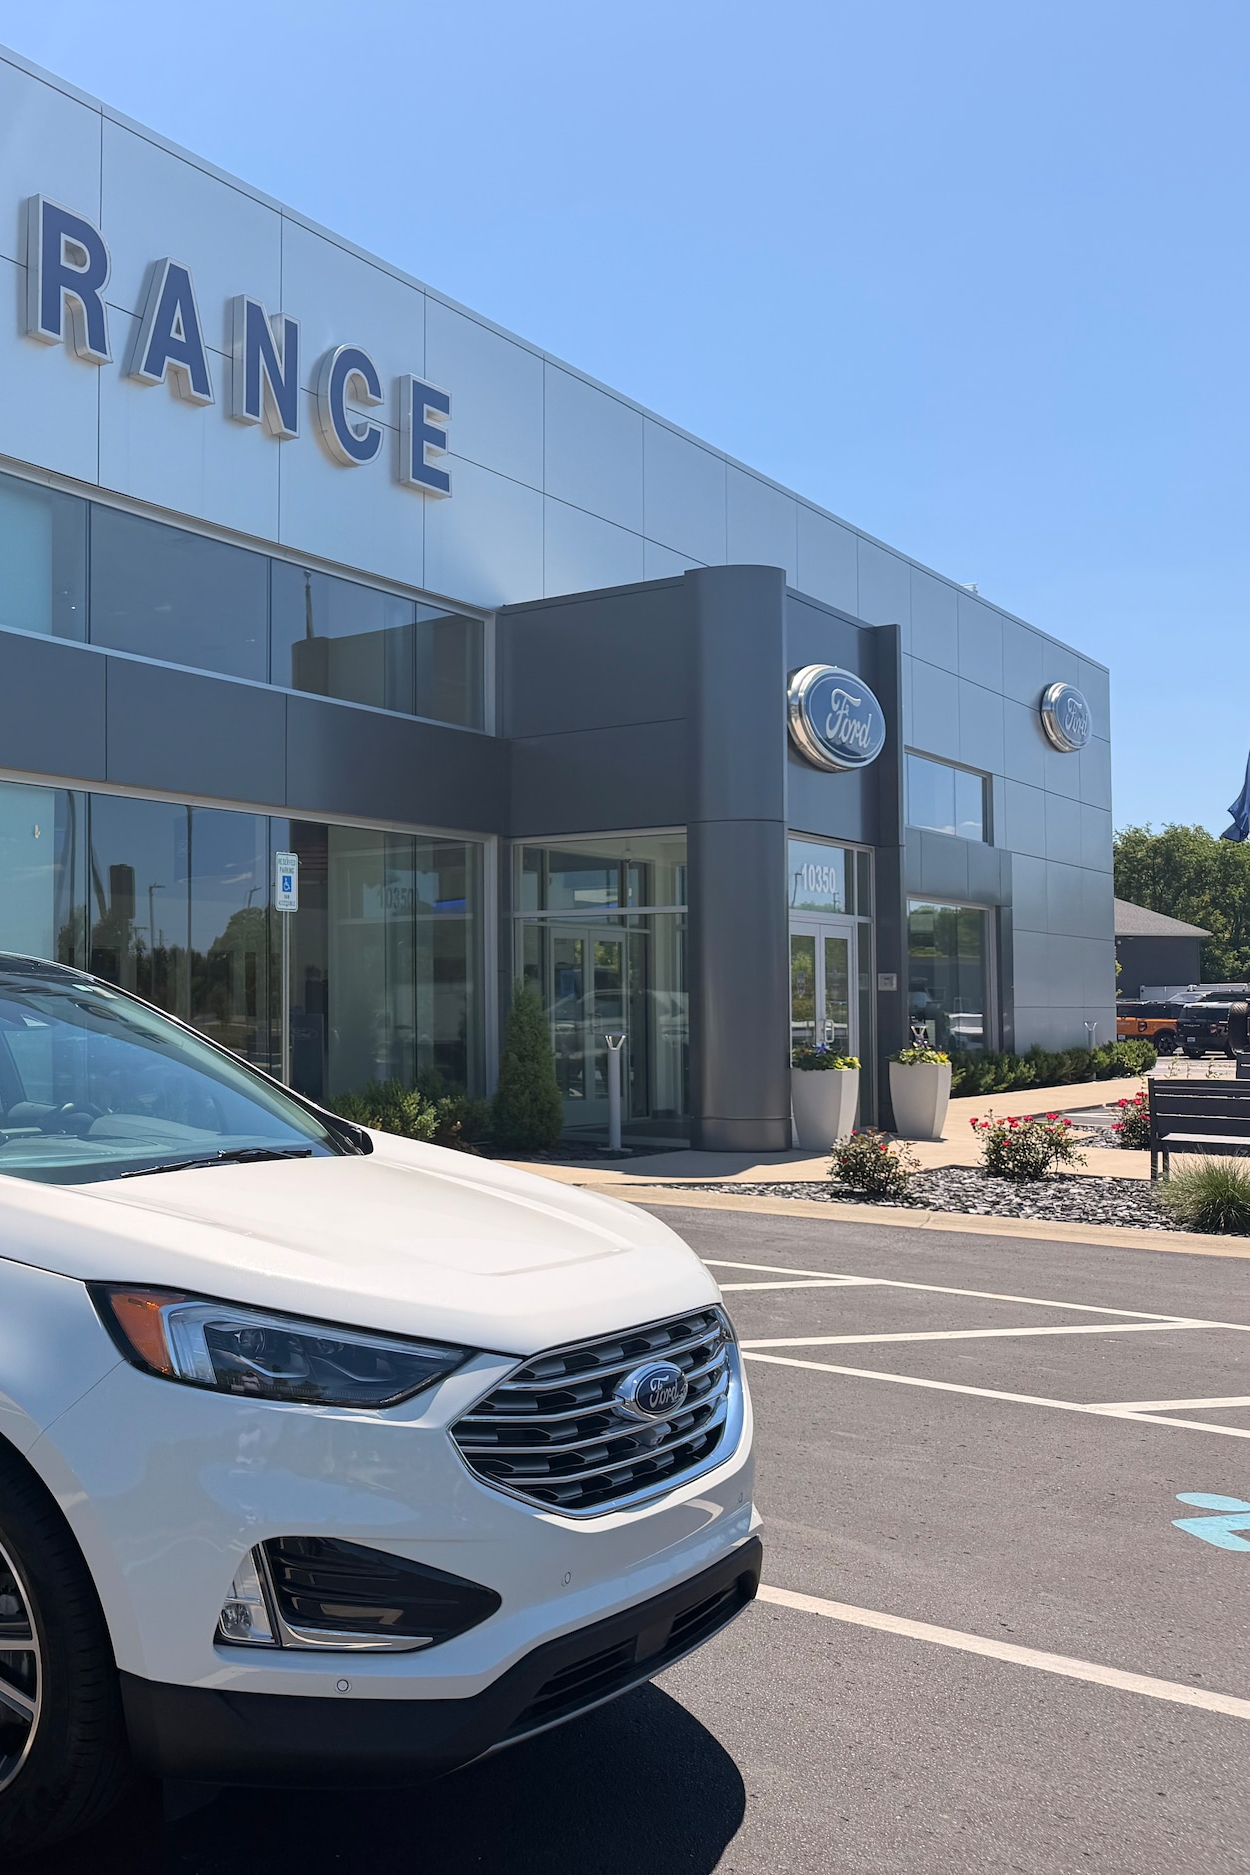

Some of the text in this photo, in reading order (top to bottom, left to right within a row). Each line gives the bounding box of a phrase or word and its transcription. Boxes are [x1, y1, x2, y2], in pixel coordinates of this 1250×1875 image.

[825, 688, 872, 749] Ford
[1065, 697, 1088, 737] Ford
[802, 863, 836, 893] 10350
[650, 1375, 679, 1408] Ford
